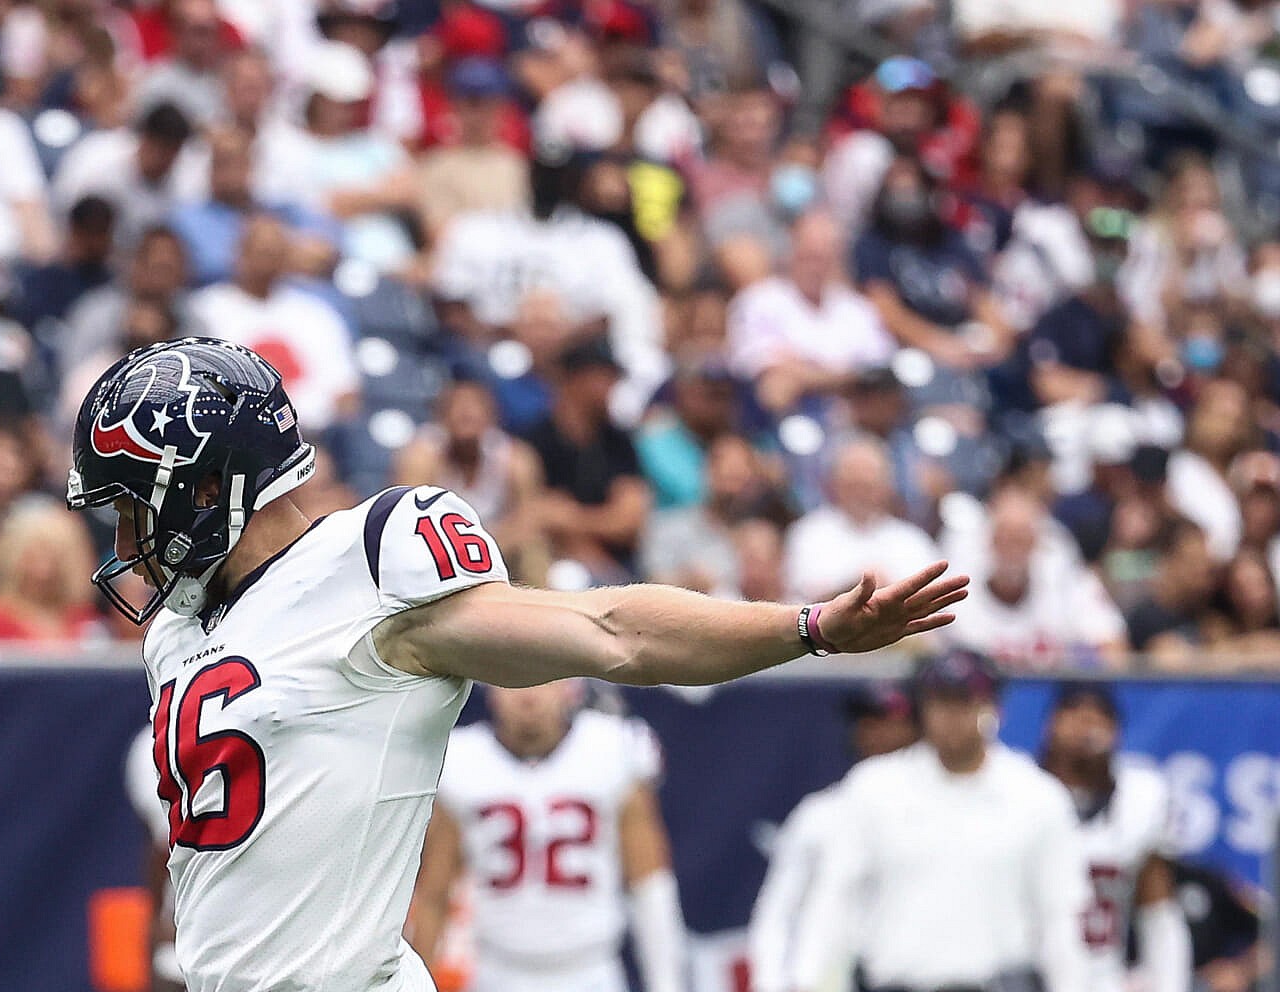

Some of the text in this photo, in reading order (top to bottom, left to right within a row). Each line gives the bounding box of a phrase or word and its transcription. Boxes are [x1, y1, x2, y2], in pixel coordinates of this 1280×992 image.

[414, 512, 493, 582] 16
[182, 643, 226, 667] TEXANS
[153, 655, 267, 853] 16
[476, 799, 597, 893] 32
